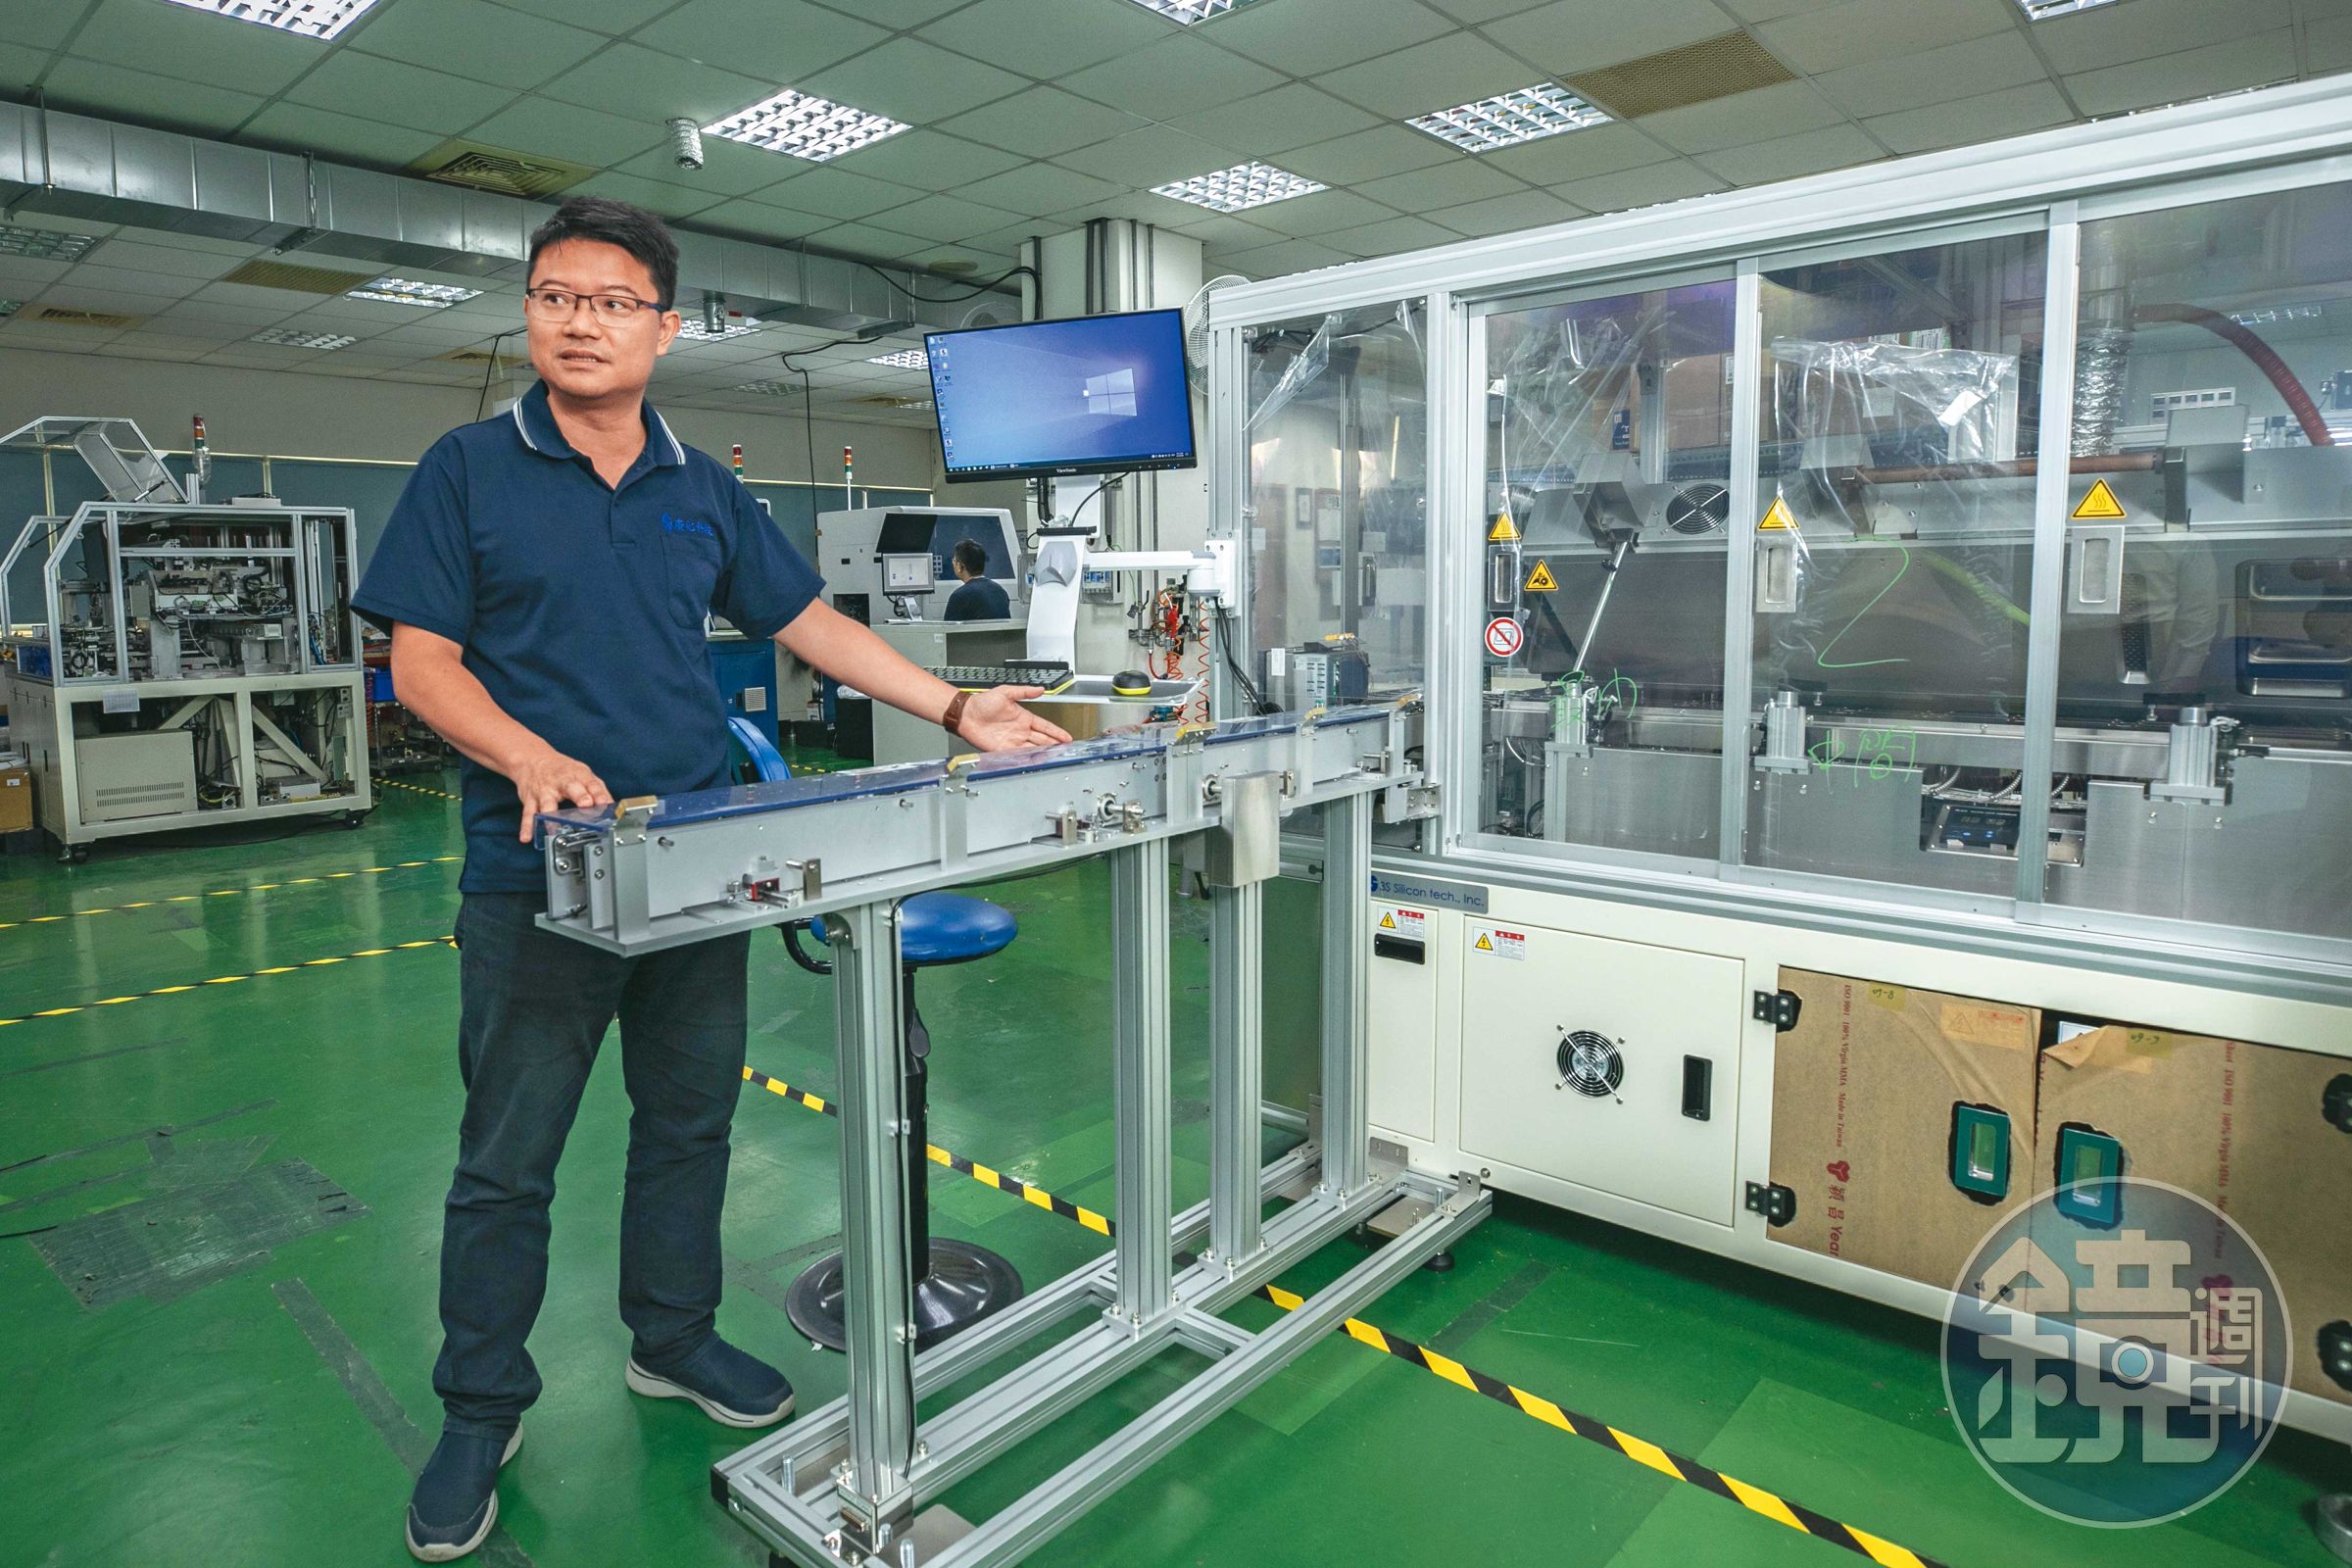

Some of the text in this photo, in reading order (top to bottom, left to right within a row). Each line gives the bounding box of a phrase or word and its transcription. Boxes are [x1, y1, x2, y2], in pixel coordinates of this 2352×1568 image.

[1379, 880, 1391, 893] 3S
[1394, 883, 1427, 897] Silicon
[1463, 894, 1485, 906] Inc.
[1842, 1000, 1851, 1016] 9001
[1841, 1021, 1850, 1041] 100%
[1838, 1042, 1849, 1064] Virgin
[1838, 1065, 1848, 1087] MMA
[1838, 1093, 1846, 1112] Made
[1836, 1121, 1845, 1148] Taiwan
